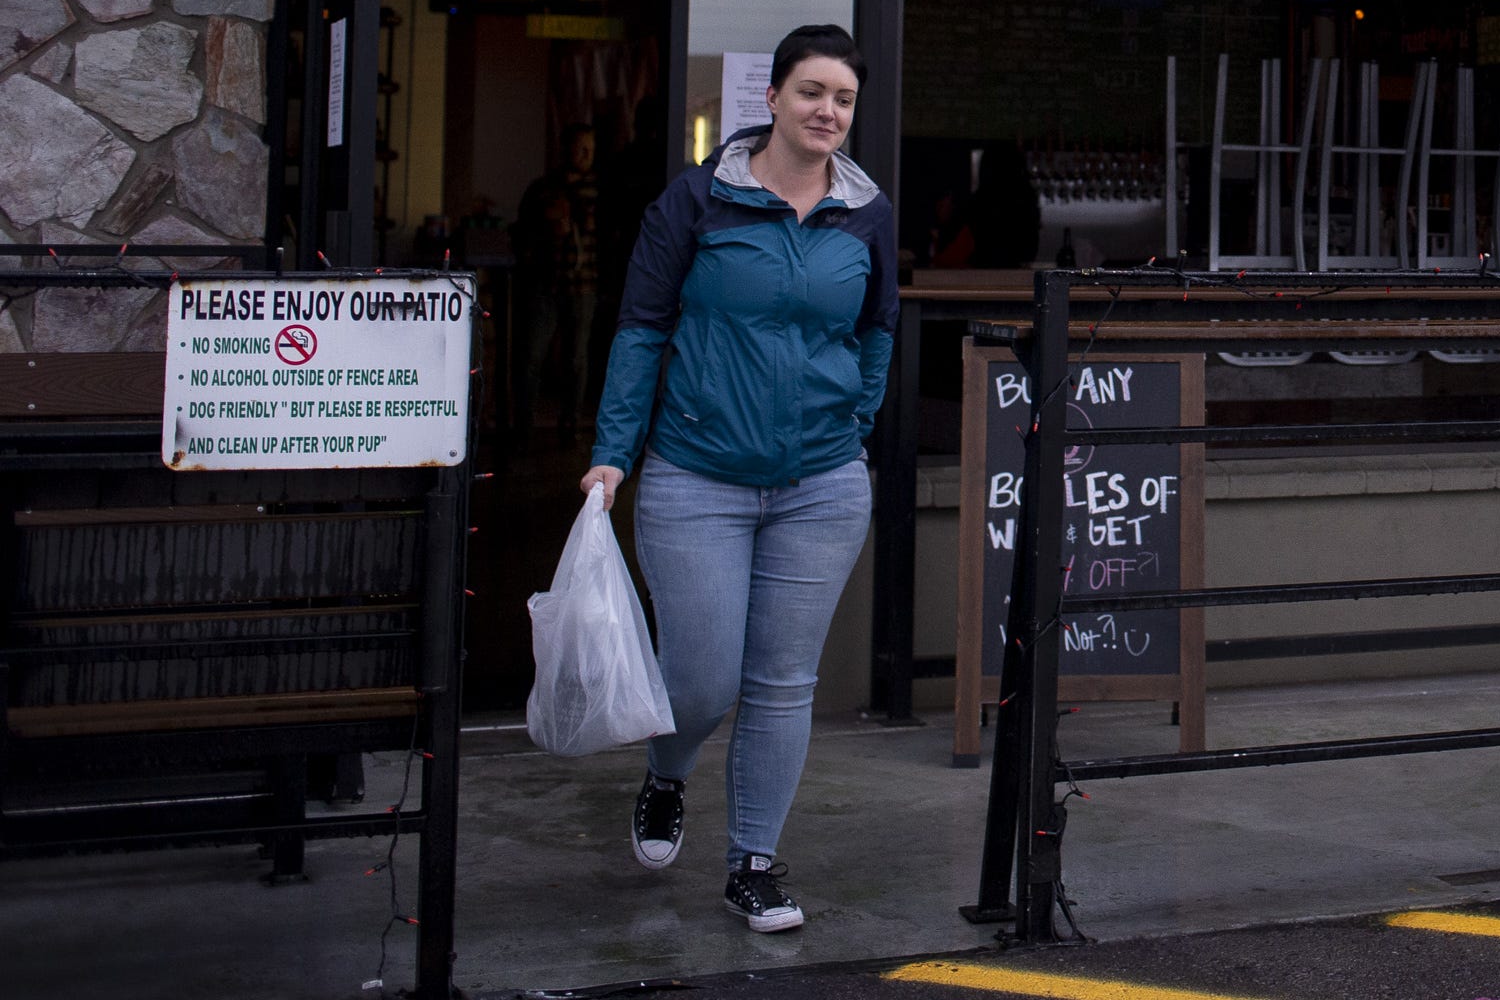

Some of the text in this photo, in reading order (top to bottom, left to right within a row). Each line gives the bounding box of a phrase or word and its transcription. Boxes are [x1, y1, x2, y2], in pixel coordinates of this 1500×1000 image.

[181, 290, 462, 321] PLEASE ENJOY OUR PATIO
[192, 337, 270, 354] NO SMOKING
[190, 369, 419, 386] NO ALCOHOL OUTSIDE OF FENCE AREA
[996, 367, 1133, 408] BU ANY
[189, 401, 215, 418] DOG
[219, 400, 278, 418] FRIENDLY
[290, 401, 315, 417] BUT
[318, 400, 362, 417] PLEASE
[366, 400, 382, 417] BE
[385, 400, 459, 417] RESPECTFUL
[188, 435, 387, 455] AND CLEAN UP AFTER YOUR PUP"
[1140, 477, 1177, 513] OF
[1089, 515, 1151, 546] GET
